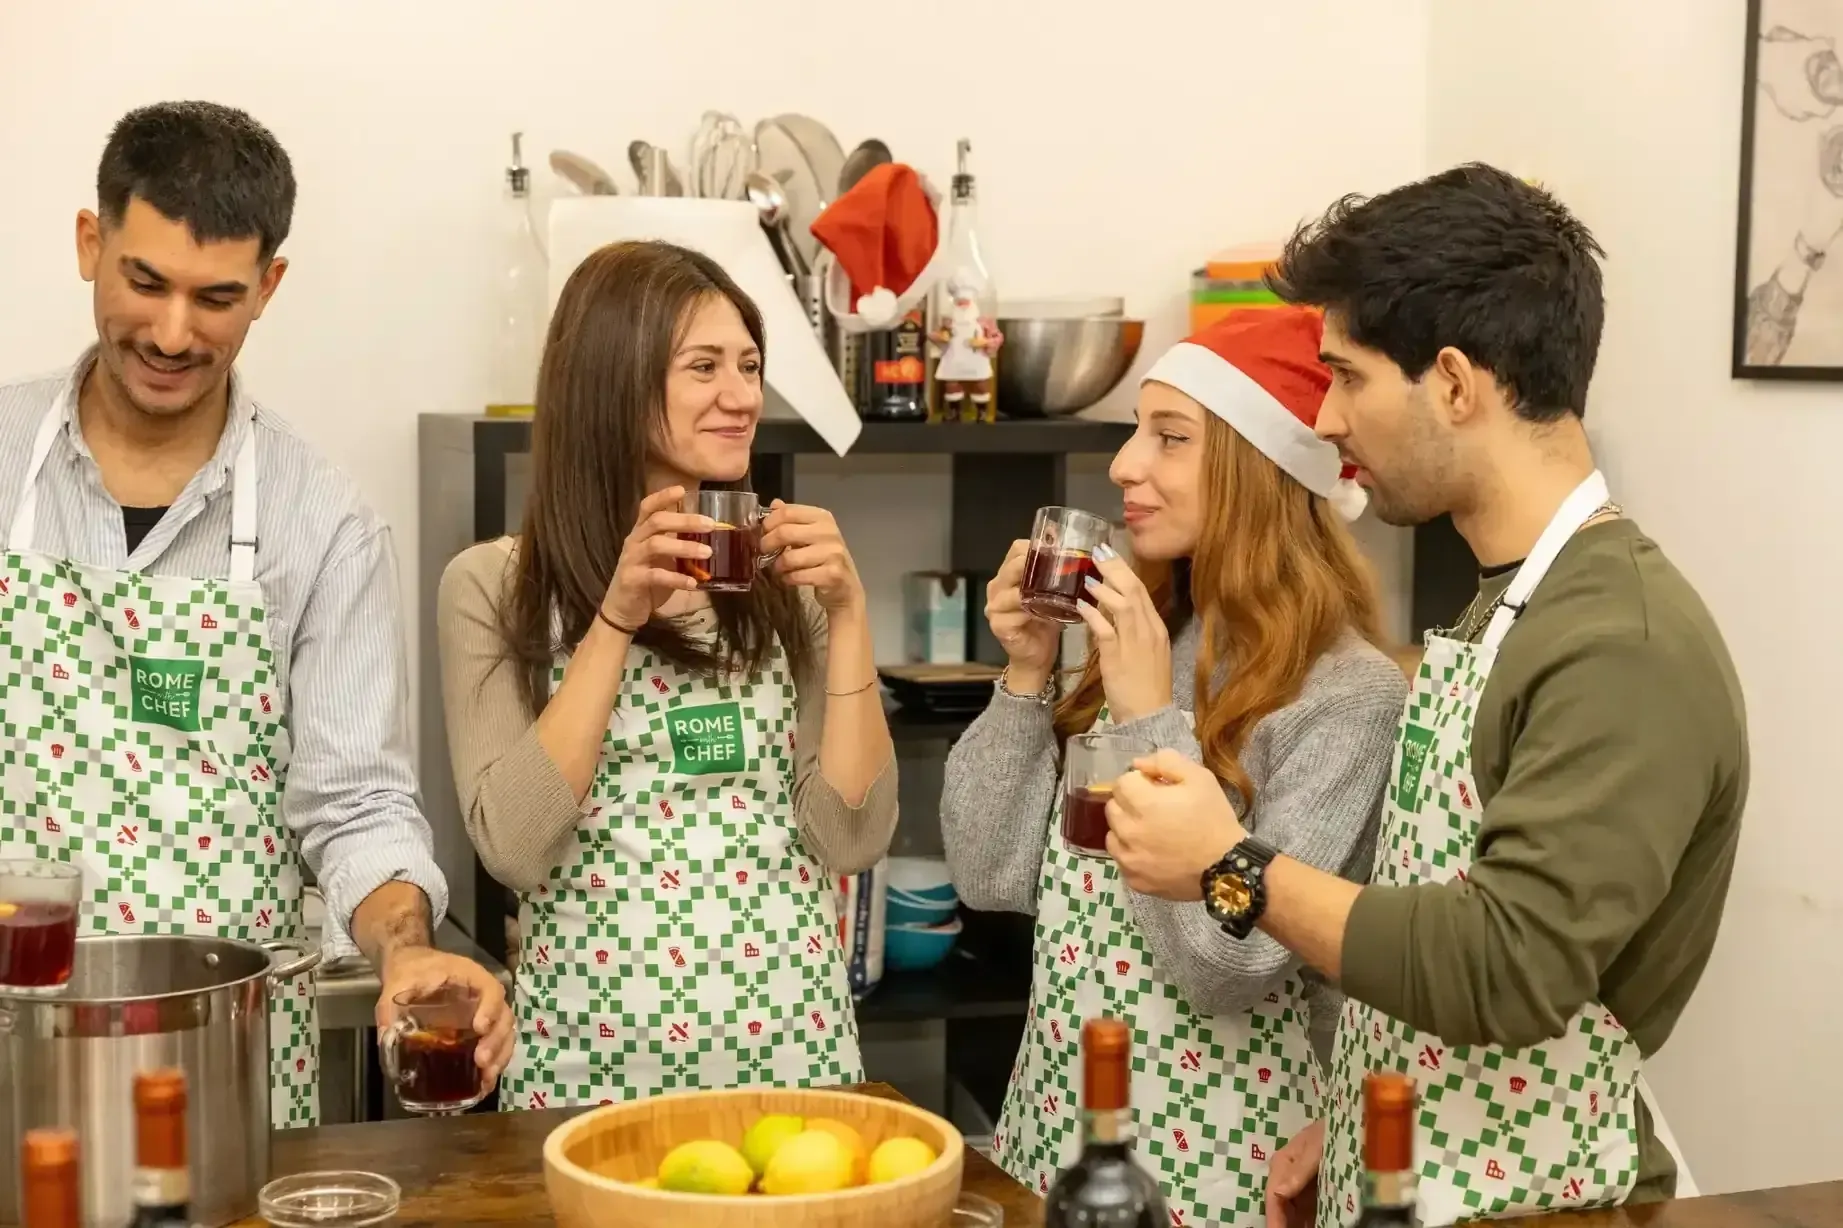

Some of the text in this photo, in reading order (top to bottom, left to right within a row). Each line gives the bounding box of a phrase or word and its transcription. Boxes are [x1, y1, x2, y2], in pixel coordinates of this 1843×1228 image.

[137, 668, 195, 690] ROME
[141, 695, 191, 718] CHEF
[674, 715, 735, 736] ROME
[683, 743, 736, 761] CHEF
